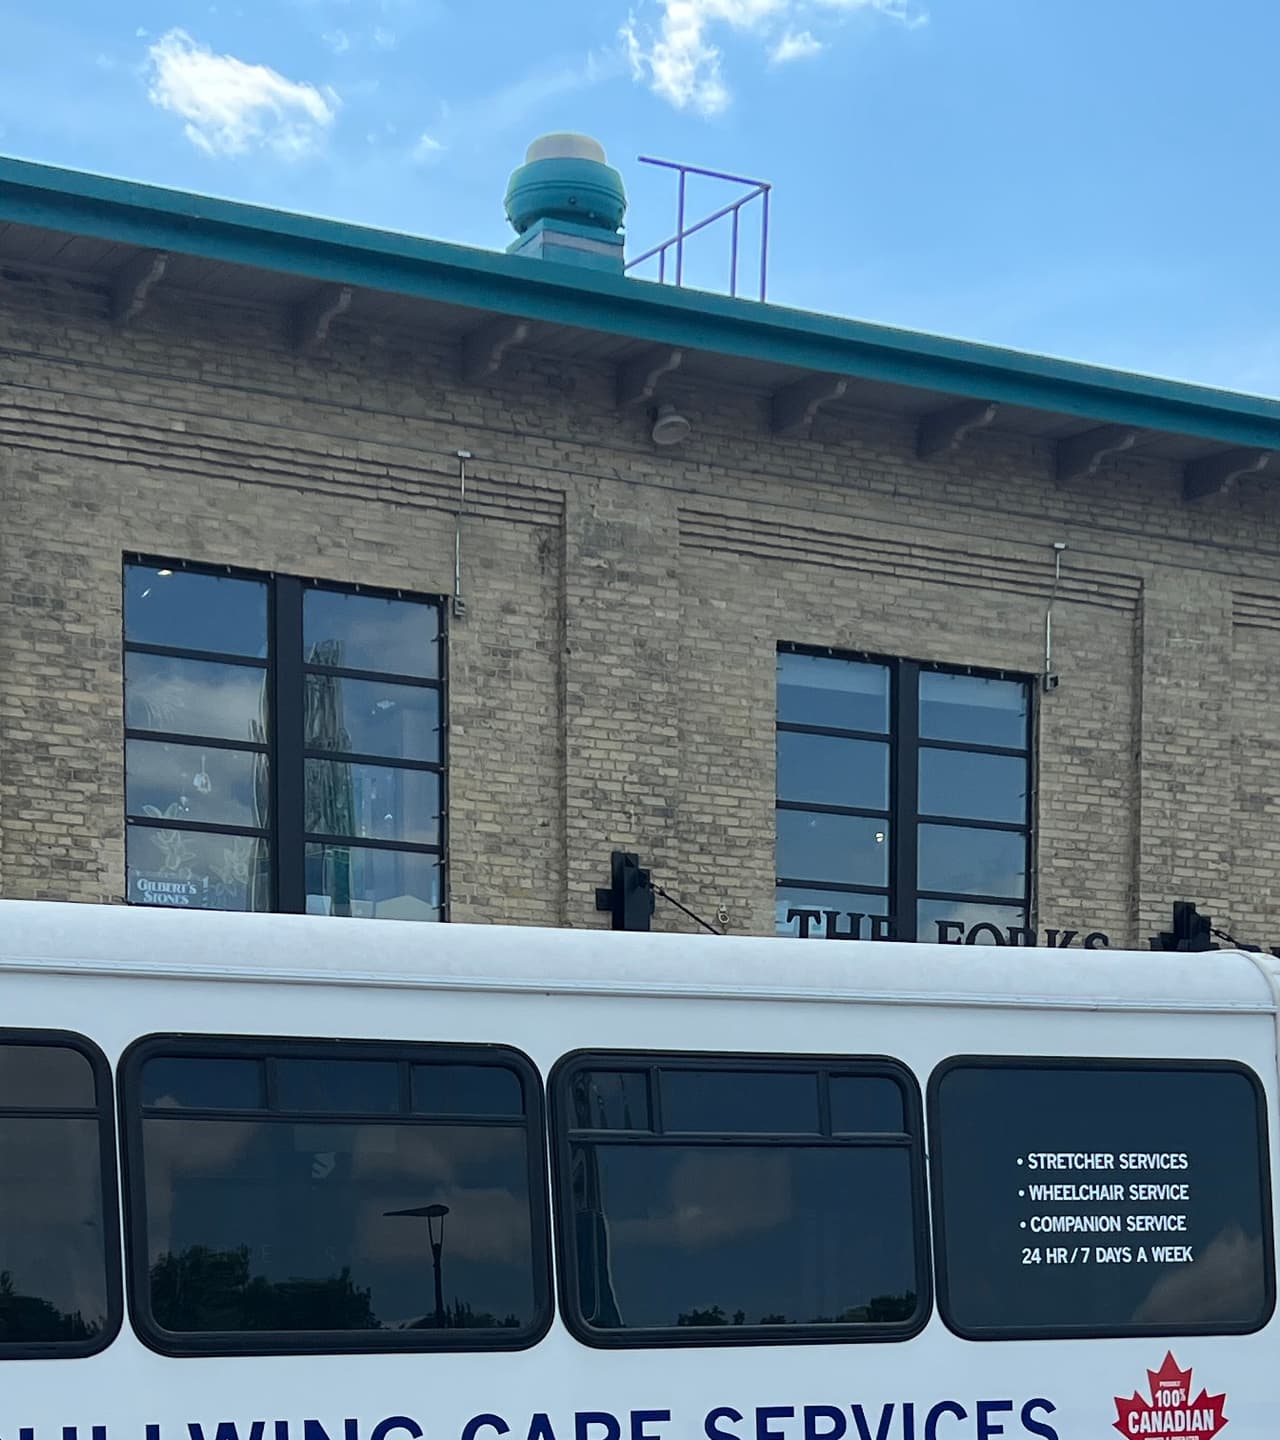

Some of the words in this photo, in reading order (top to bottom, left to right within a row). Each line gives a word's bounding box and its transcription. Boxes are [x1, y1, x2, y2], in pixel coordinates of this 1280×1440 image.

[1027, 1152, 1115, 1170] STRETCHER
[1119, 1152, 1189, 1170] SERVICES
[1028, 1184, 1125, 1202] WHEELCHAIR
[1128, 1183, 1190, 1201] SERVICE
[1030, 1215, 1122, 1233] COMPANION
[1126, 1214, 1187, 1232] SERVICE
[1021, 1247, 1042, 1264] 24
[1096, 1246, 1132, 1263] DAYS
[1136, 1246, 1148, 1262] A
[1150, 1246, 1194, 1263] WEEK
[1127, 1408, 1215, 1434] CANADIAN
